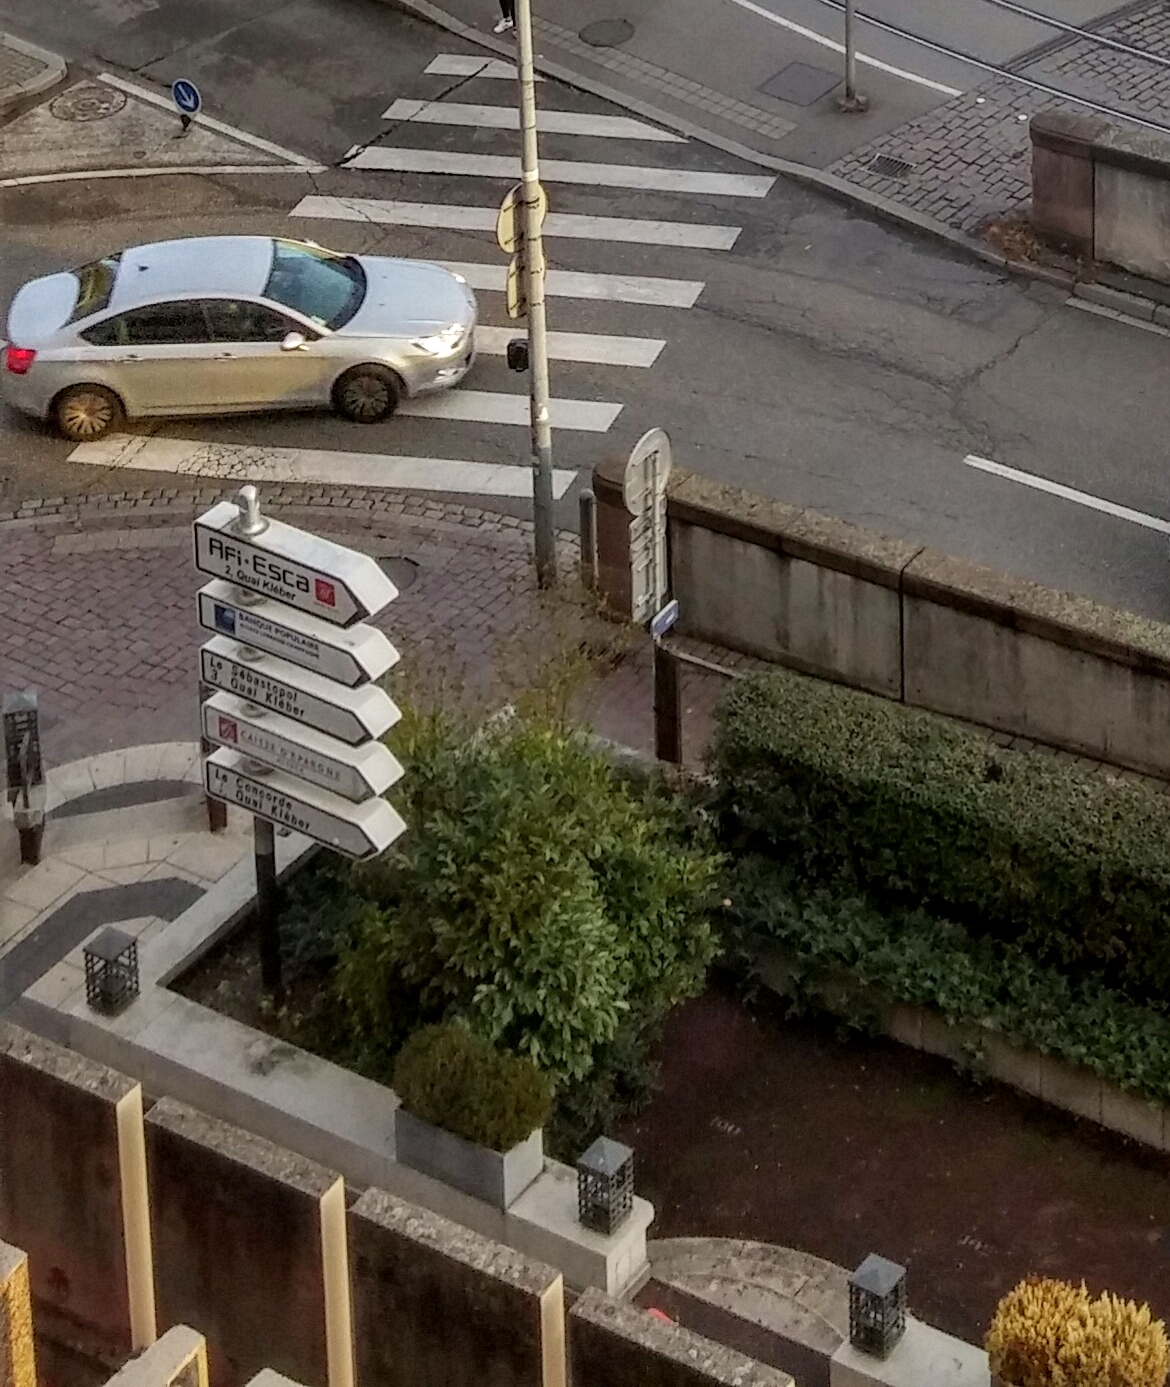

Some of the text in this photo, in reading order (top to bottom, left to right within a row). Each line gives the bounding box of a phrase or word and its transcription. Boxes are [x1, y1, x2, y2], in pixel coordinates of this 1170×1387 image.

[236, 570, 260, 587] Quai
[262, 579, 297, 601] Kléber
[239, 612, 319, 651] BANQUE POPULAIRE
[210, 656, 298, 702] Le Sébastopol
[230, 677, 257, 697] Quai
[265, 692, 305, 716] Kléber
[240, 730, 275, 751] CAISSE
[215, 769, 293, 810] Le Concorde
[235, 790, 262, 810] Quai
[271, 806, 310, 831] Kléber
